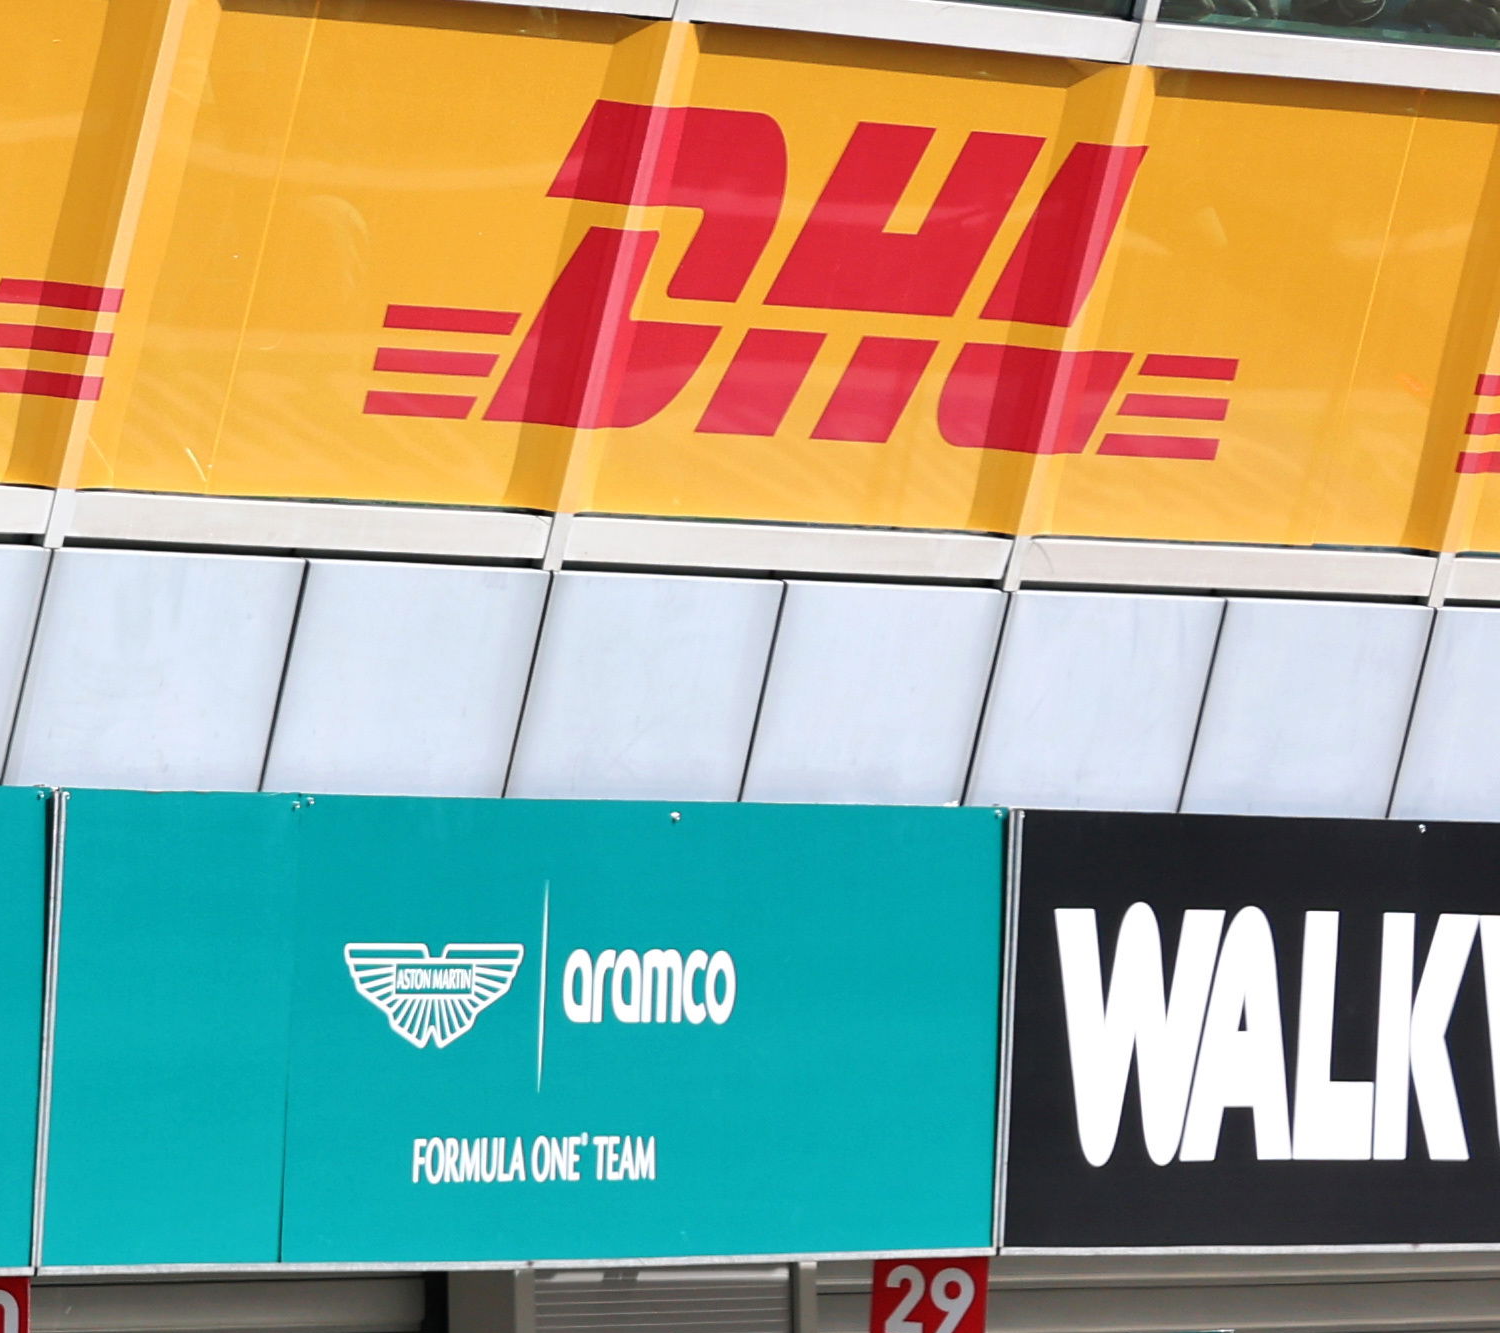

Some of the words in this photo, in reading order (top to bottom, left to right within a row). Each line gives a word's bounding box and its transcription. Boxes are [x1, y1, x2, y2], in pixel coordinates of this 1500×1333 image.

[482, 98, 1149, 456] DHL
[396, 967, 431, 991] ASTON
[433, 967, 473, 991] MARTIN
[562, 948, 737, 1025] aramco
[1054, 901, 1500, 1167] WALK
[412, 1136, 526, 1185] FORMULA
[593, 1135, 656, 1181] TEAM
